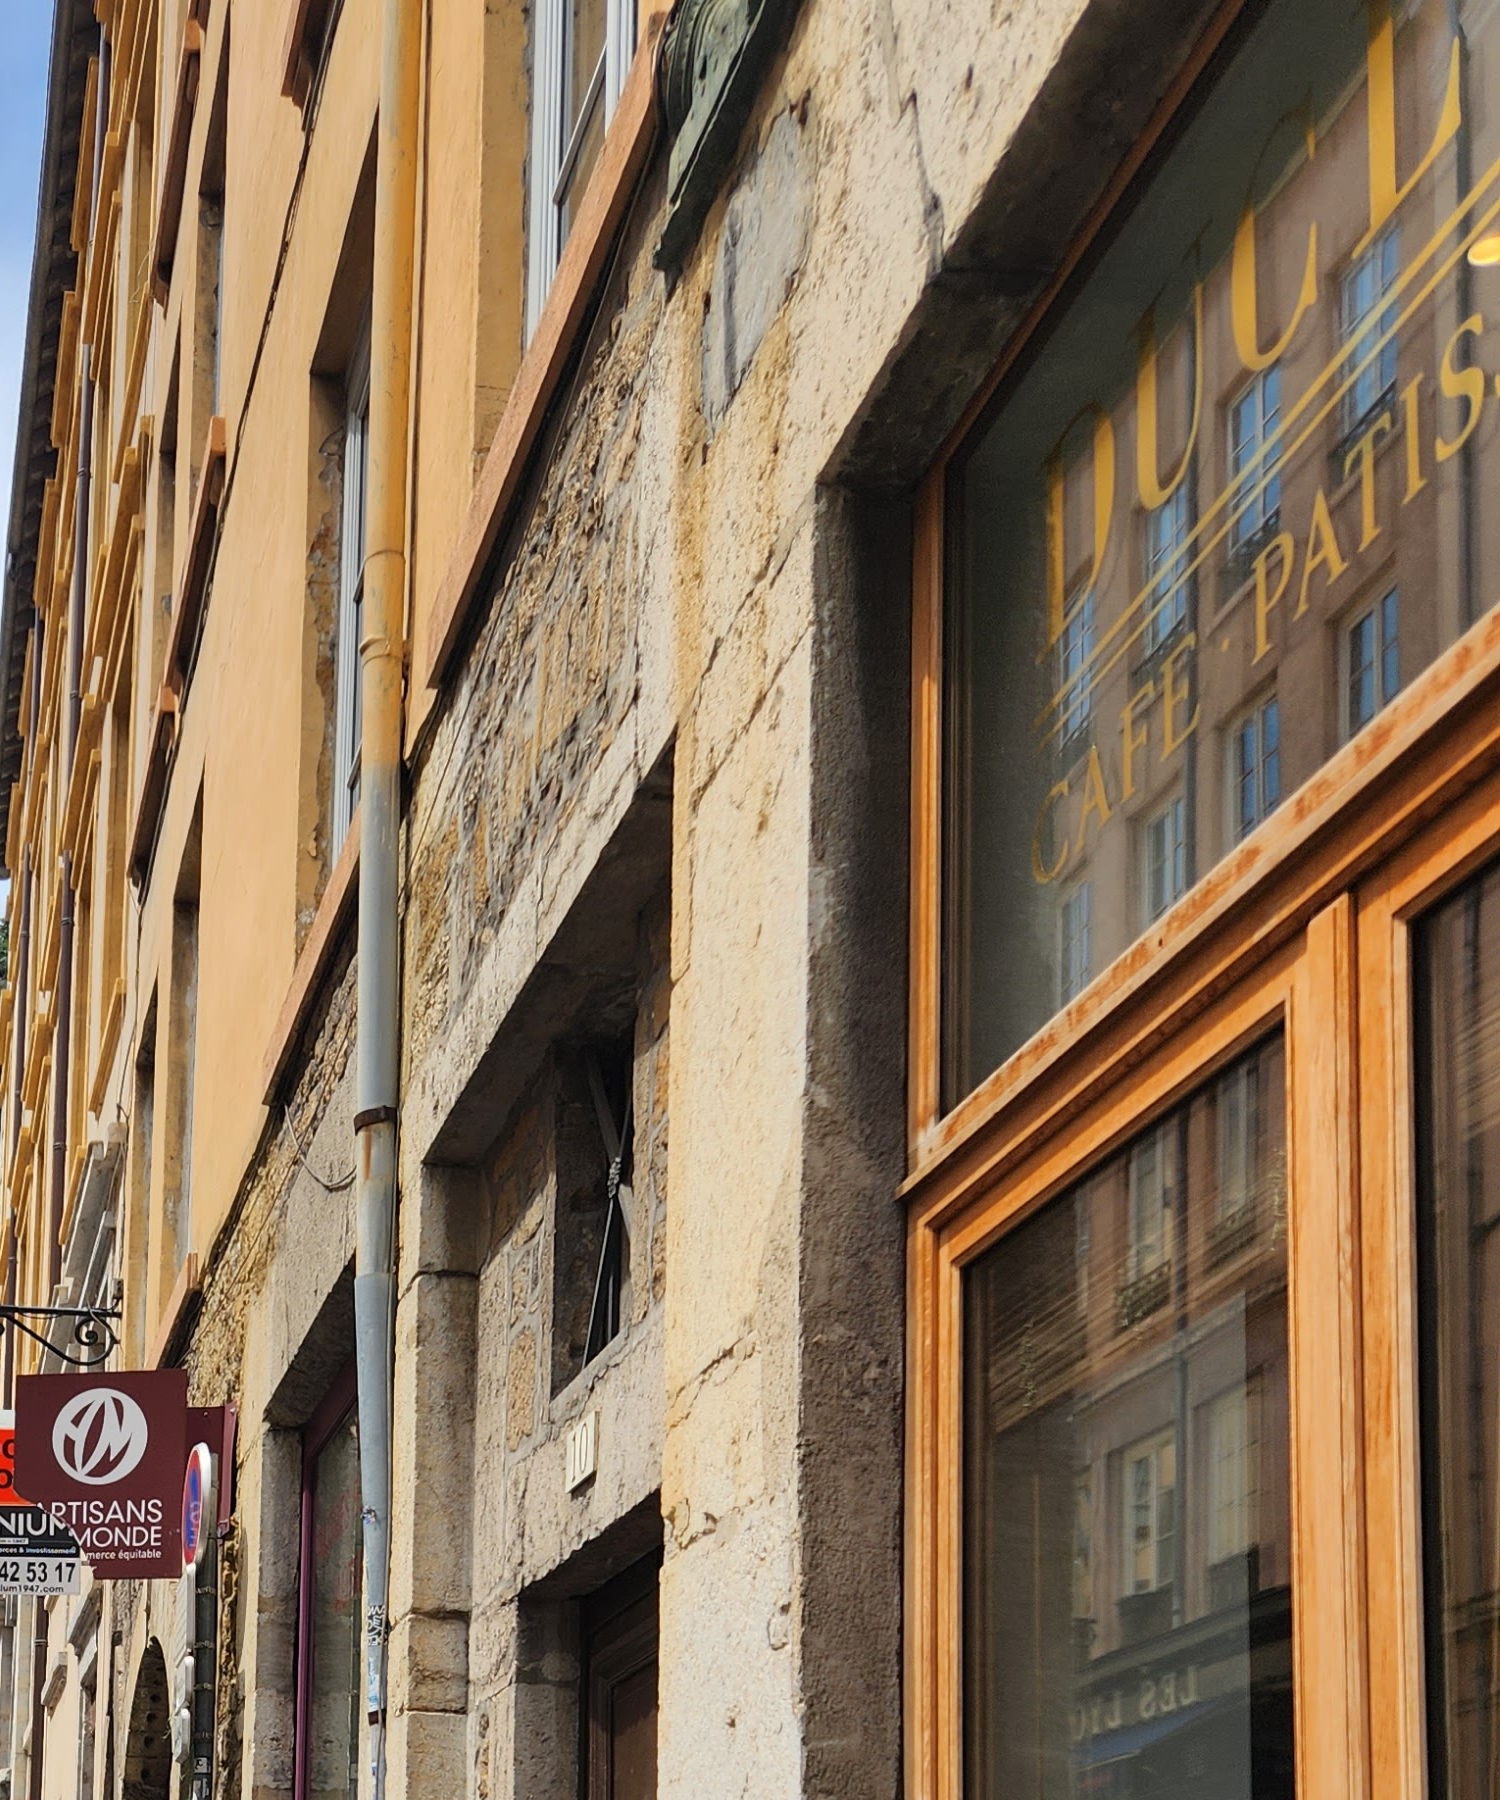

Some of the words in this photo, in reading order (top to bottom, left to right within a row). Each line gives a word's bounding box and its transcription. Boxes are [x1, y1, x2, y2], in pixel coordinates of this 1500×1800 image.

[1032, 631, 1200, 884] CAFE
[1250, 313, 1500, 665] PATIS
[571, 1422, 589, 1483] 10
[37, 1500, 163, 1524] RTISANS
[85, 1550, 116, 1560] merce
[118, 1549, 162, 1561] équitable
[26, 1562, 48, 1583] 53
[55, 1562, 76, 1583] 17
